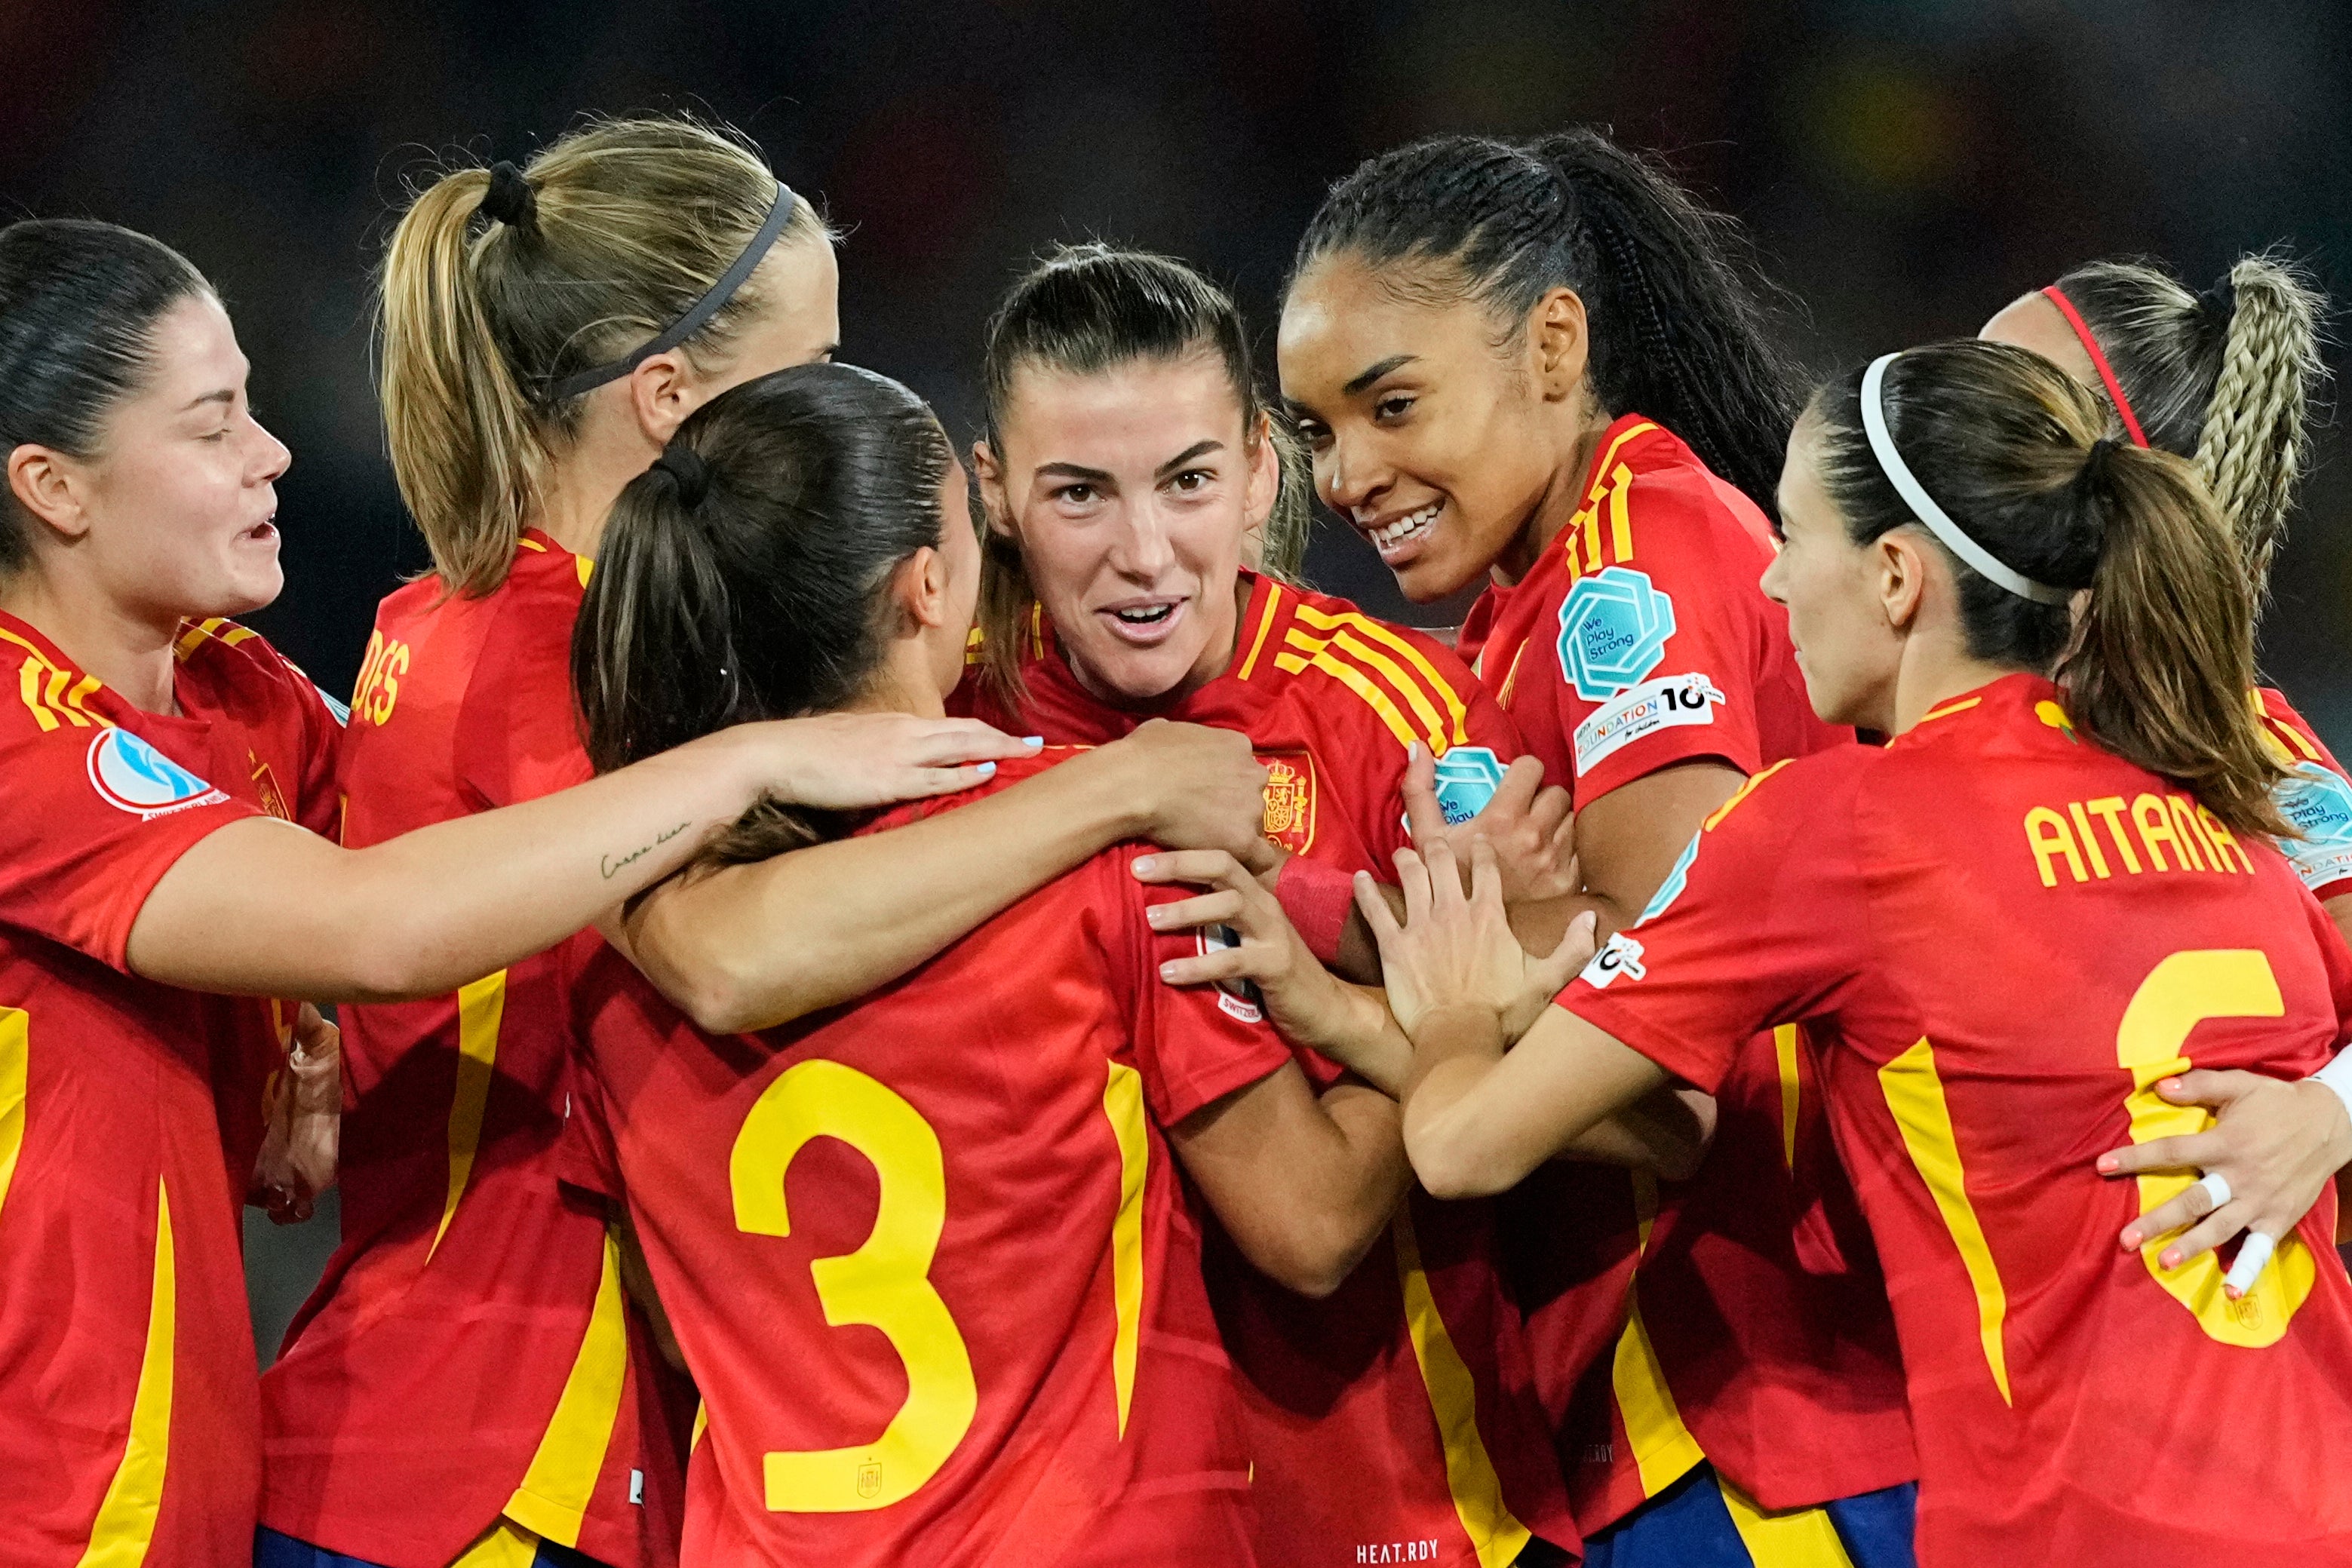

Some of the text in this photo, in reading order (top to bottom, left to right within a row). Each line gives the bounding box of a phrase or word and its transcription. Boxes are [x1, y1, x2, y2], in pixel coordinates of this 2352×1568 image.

[1583, 617, 1602, 631] We
[1661, 687, 1705, 710] 10
[1577, 699, 1658, 757] FOUNDATION
[2024, 793, 2255, 887] AITANA
[2117, 949, 2316, 1349] 6
[729, 1059, 978, 1513] 3
[1356, 1538, 1439, 1564] HEAT.RDY
